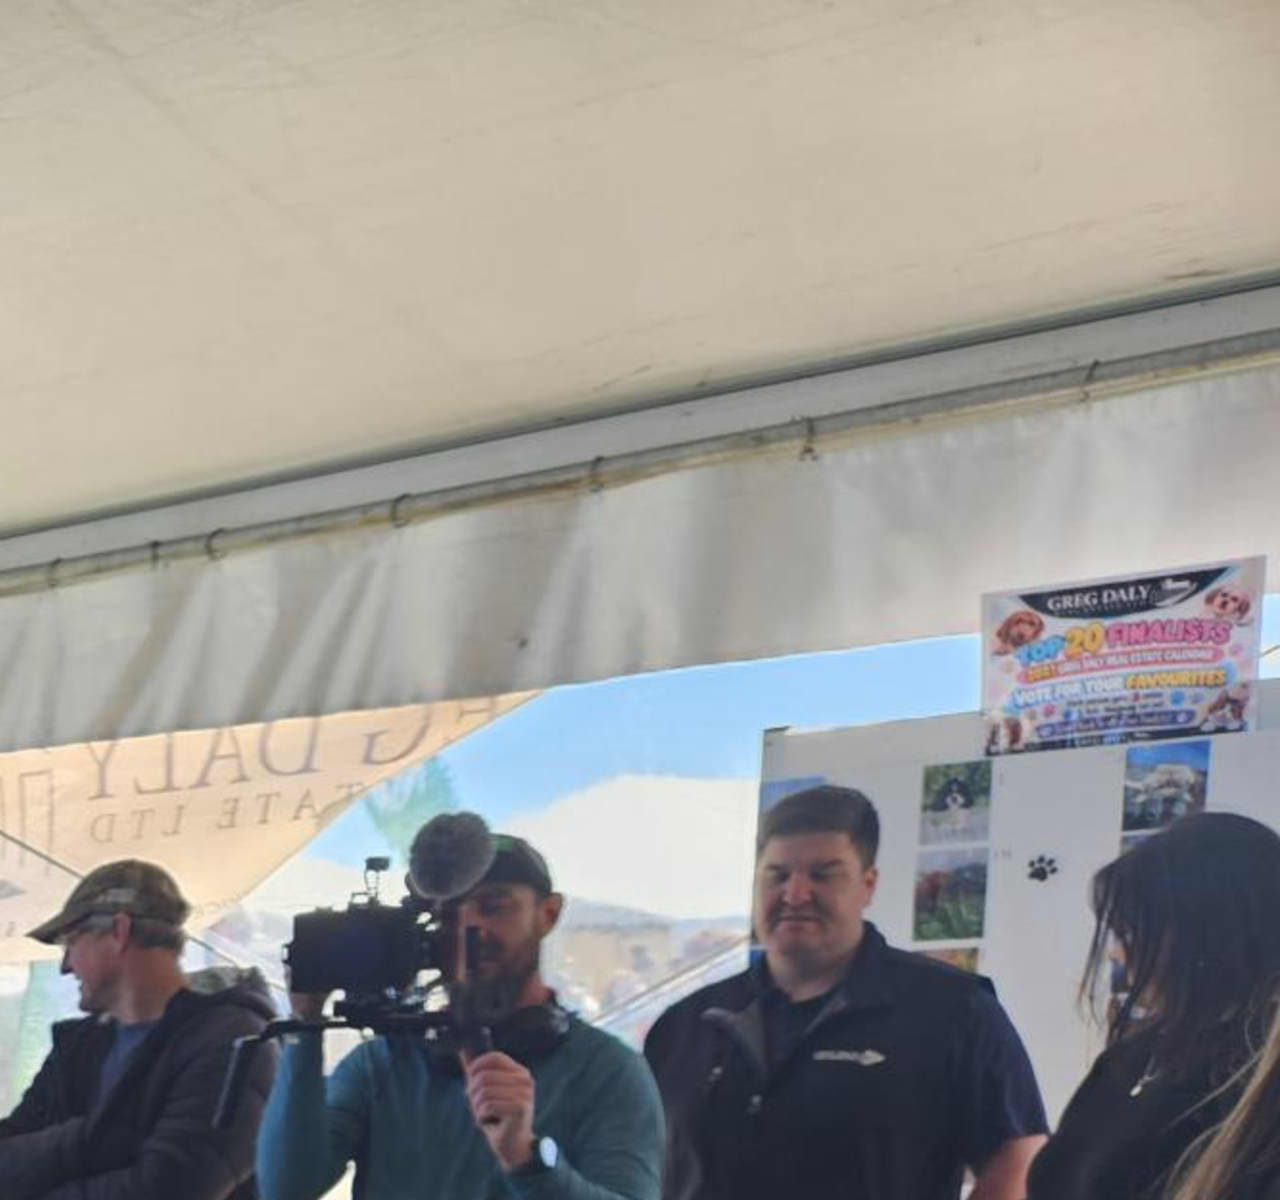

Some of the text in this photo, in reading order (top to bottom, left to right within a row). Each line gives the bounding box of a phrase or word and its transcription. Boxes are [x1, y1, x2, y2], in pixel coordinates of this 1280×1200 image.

[1046, 589, 1100, 611] GREG
[1102, 584, 1152, 606] DALY
[1017, 635, 1066, 666] TOP
[1065, 621, 1106, 659] 20
[1106, 618, 1232, 648] FINALISTS
[1125, 669, 1226, 689] FAVOURITES
